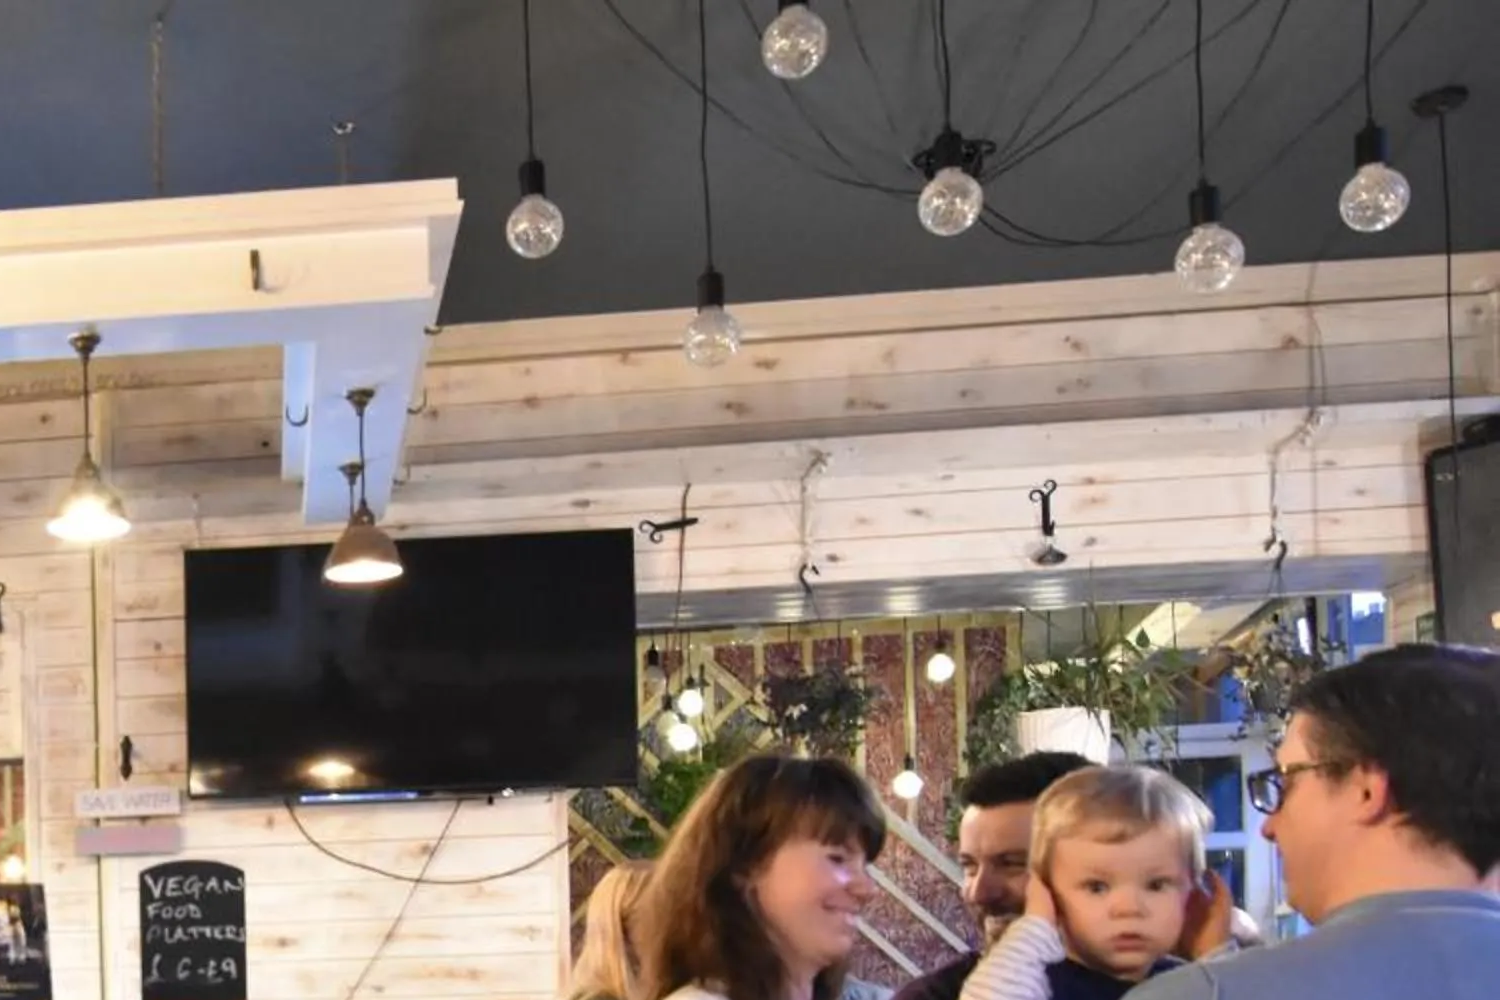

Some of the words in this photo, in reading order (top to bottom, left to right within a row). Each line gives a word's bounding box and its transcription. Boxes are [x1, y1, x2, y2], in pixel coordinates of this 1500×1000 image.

[144, 874, 244, 899] VEGAN
[146, 901, 202, 919] FOOD
[145, 924, 246, 944] PLATTERS
